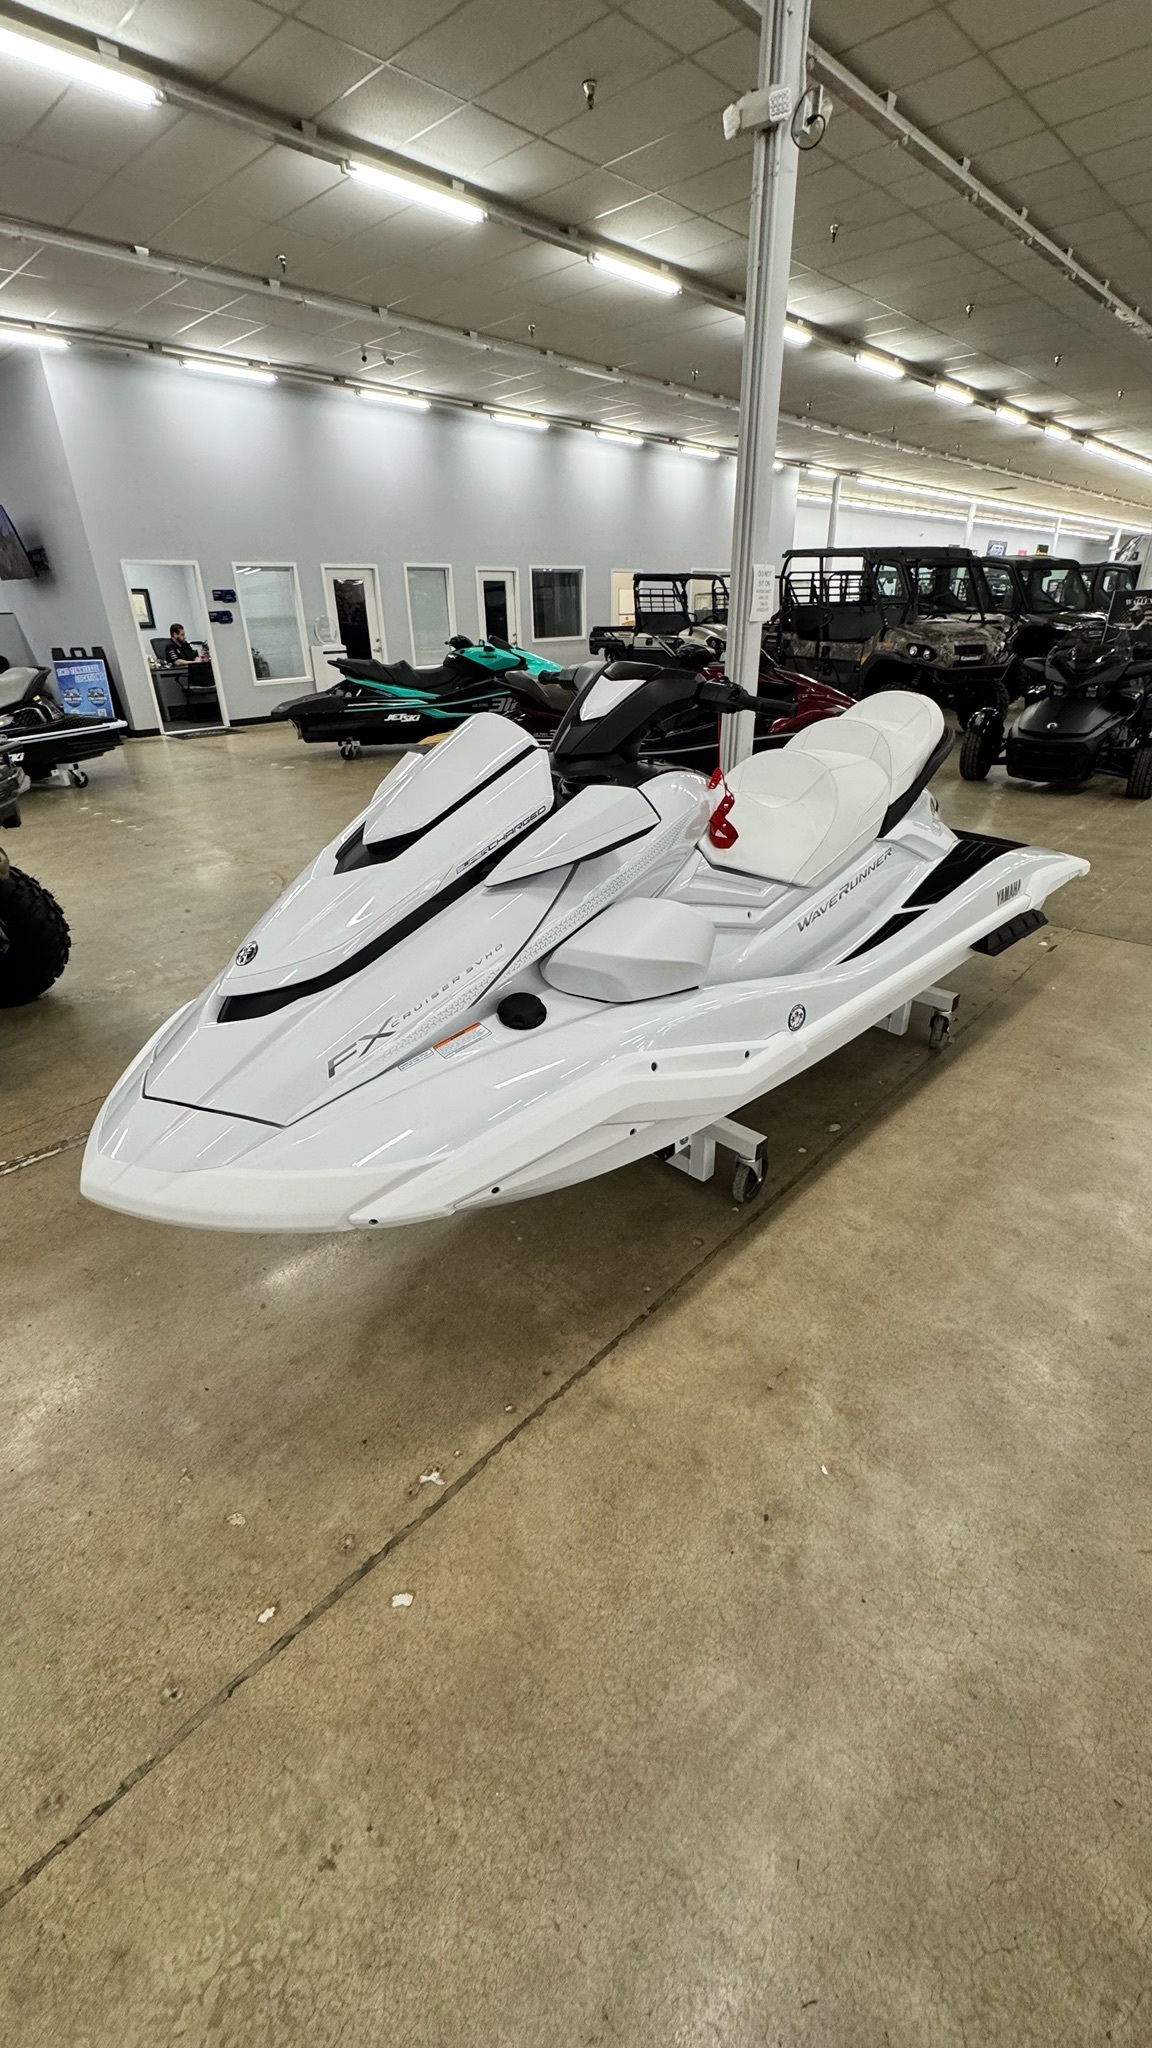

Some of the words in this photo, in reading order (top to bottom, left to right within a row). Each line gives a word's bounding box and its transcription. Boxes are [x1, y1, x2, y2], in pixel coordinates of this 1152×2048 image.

[75, 672, 105, 683] LOCATIONS
[996, 879, 1021, 907] YAMAHA
[327, 1014, 397, 1079] FX
[391, 974, 461, 1029] CRUISER
[465, 943, 504, 975] SVHO
